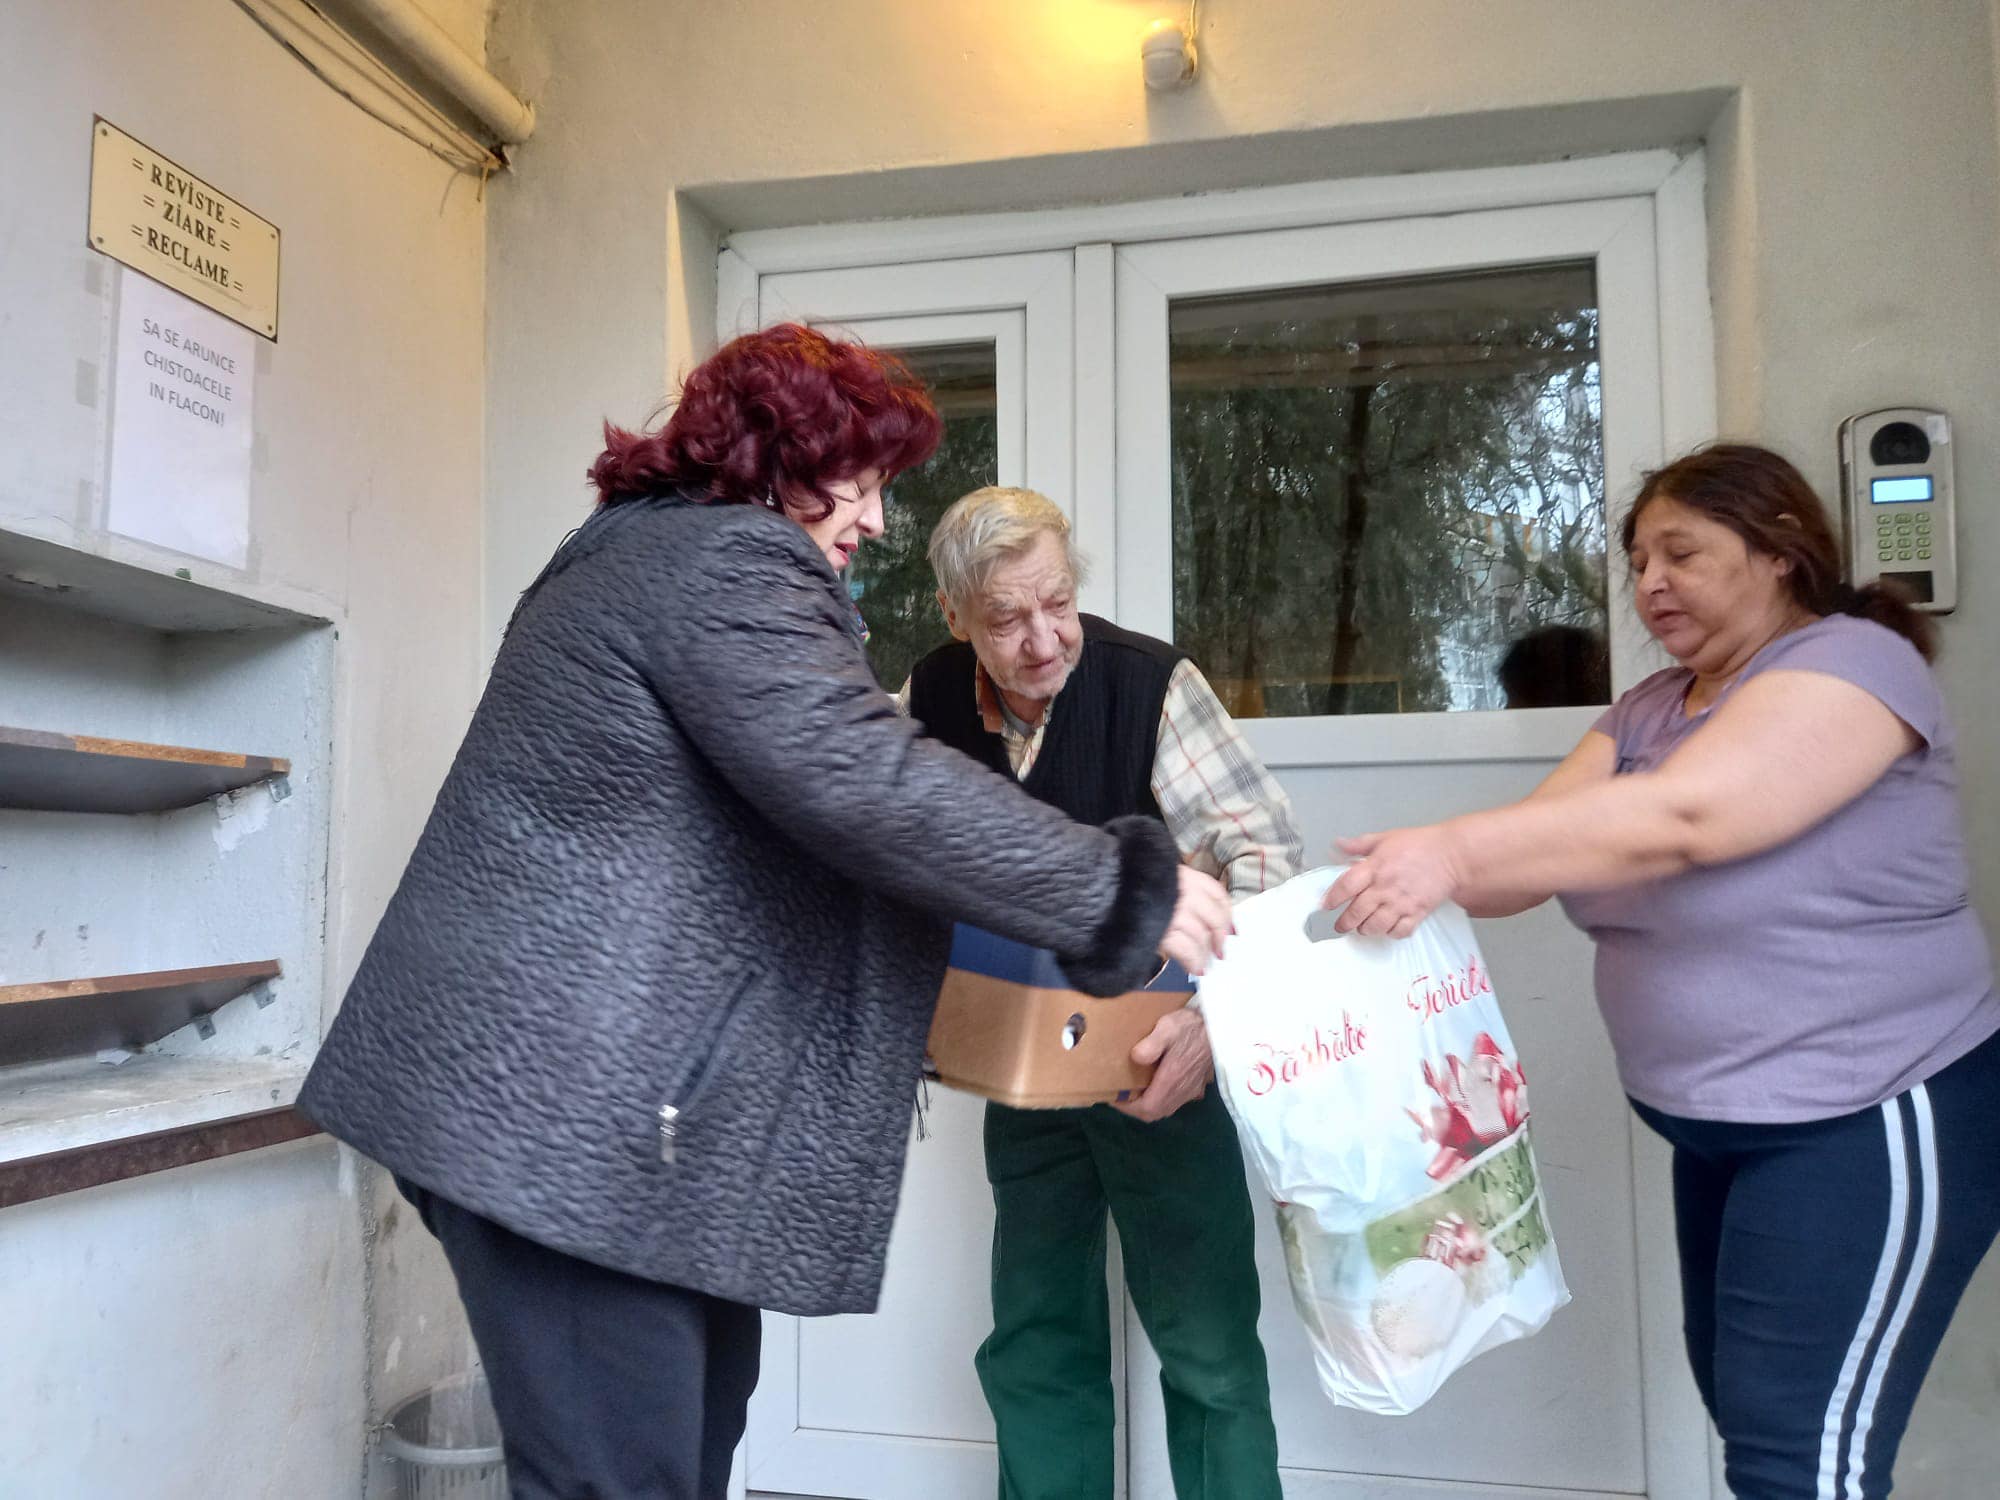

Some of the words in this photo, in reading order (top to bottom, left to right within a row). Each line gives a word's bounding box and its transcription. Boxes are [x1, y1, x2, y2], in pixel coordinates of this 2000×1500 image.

[147, 226, 230, 288] RECLAME
[143, 318, 161, 340] SA
[164, 328, 180, 348] SE
[183, 338, 236, 375] ARUNCE
[143, 350, 233, 402] CHISTOACELE
[149, 381, 165, 402] IN
[168, 389, 225, 428] FLACON!
